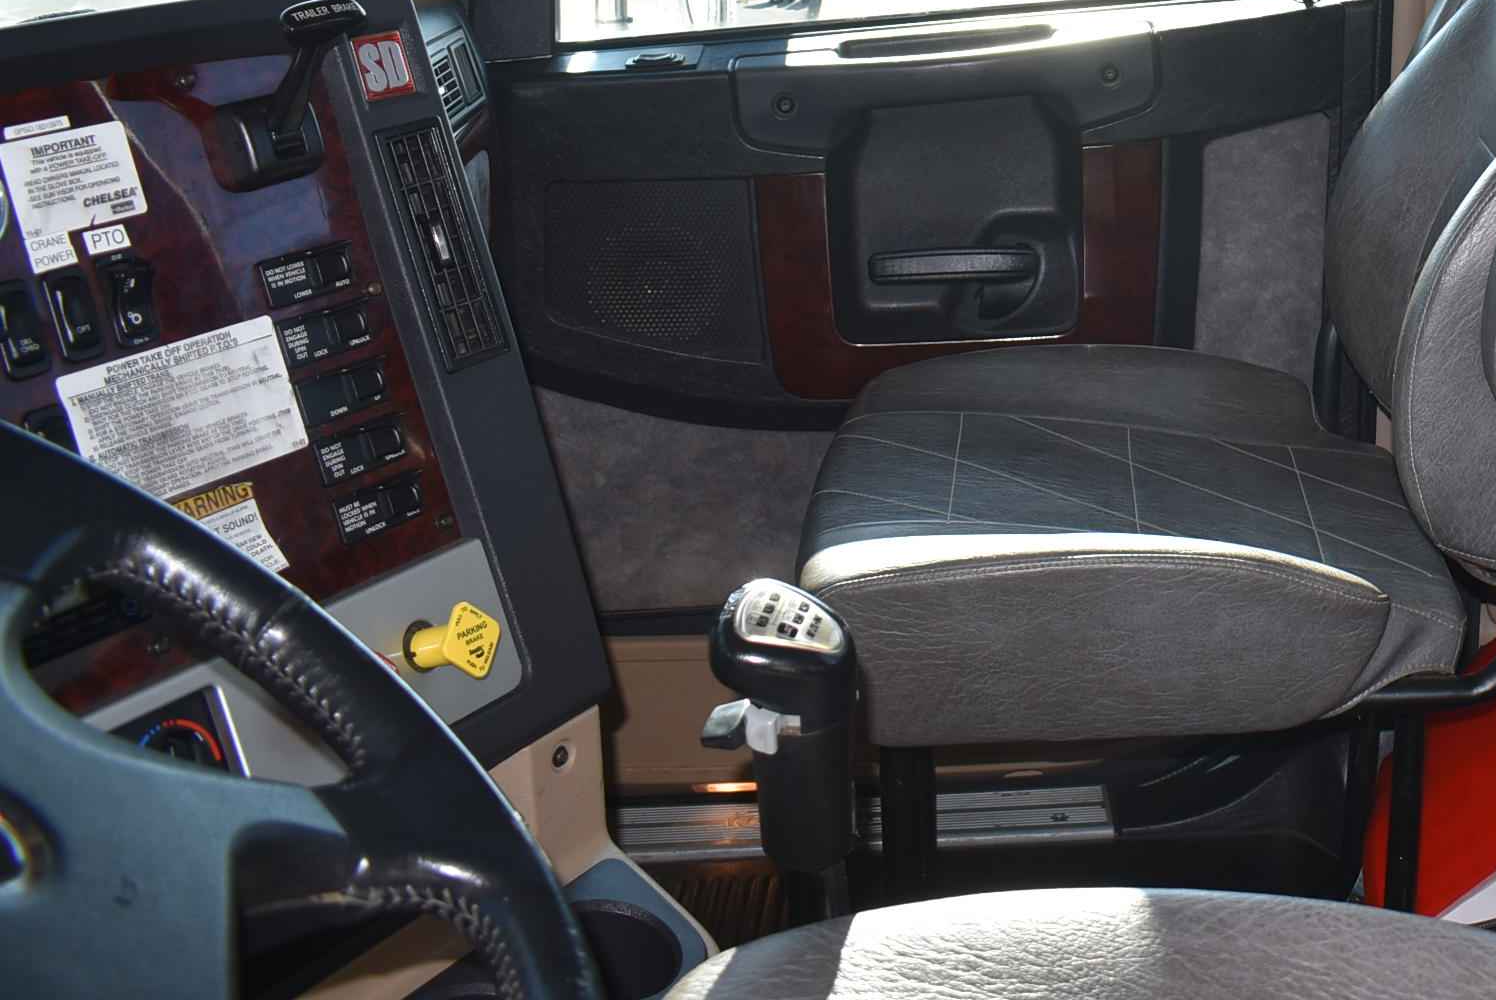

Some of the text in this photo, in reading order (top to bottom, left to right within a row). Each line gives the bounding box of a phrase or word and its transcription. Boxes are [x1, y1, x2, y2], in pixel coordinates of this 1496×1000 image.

[291, 2, 359, 22] TRAILER BRAKE
[359, 41, 409, 92] SD
[31, 135, 95, 155] IMPORTANT
[83, 187, 137, 207] CHELSEA
[31, 234, 66, 251] CRANE
[92, 228, 125, 249] PTO
[35, 249, 75, 270] POWER
[106, 330, 232, 374] POWER TAKE OFF OPERATION
[104, 357, 172, 385] MECHANICALLY
[176, 485, 249, 518] ARNING
[223, 513, 257, 533] SOUND!
[457, 620, 488, 640] PARKING
[465, 633, 484, 645] BRAKE
